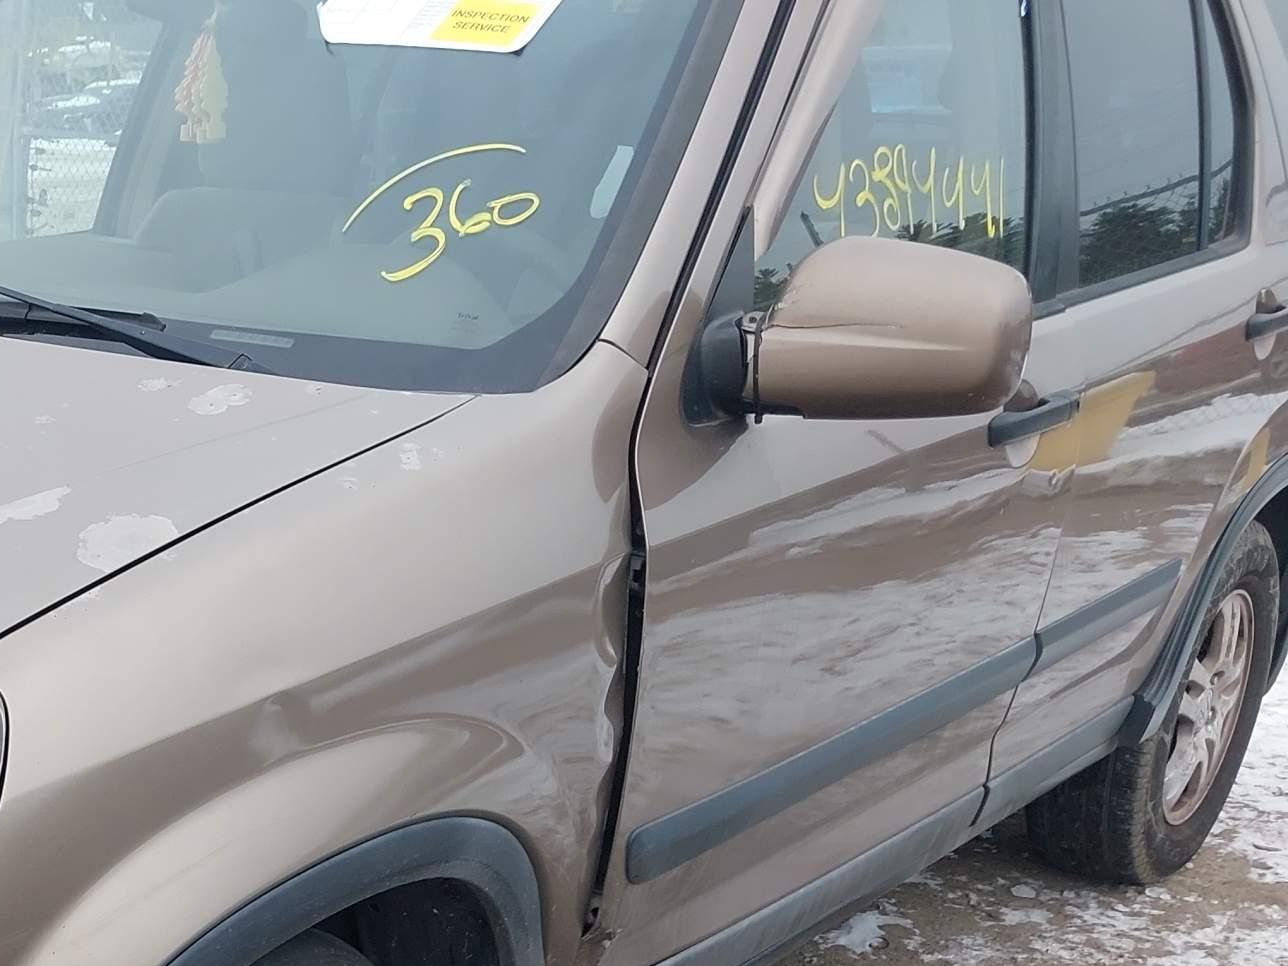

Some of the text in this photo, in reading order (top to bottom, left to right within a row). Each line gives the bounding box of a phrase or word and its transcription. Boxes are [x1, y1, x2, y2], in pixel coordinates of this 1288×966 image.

[451, 9, 530, 24] INSPECTION
[452, 21, 512, 34] SERVICE
[380, 178, 540, 282] 360
